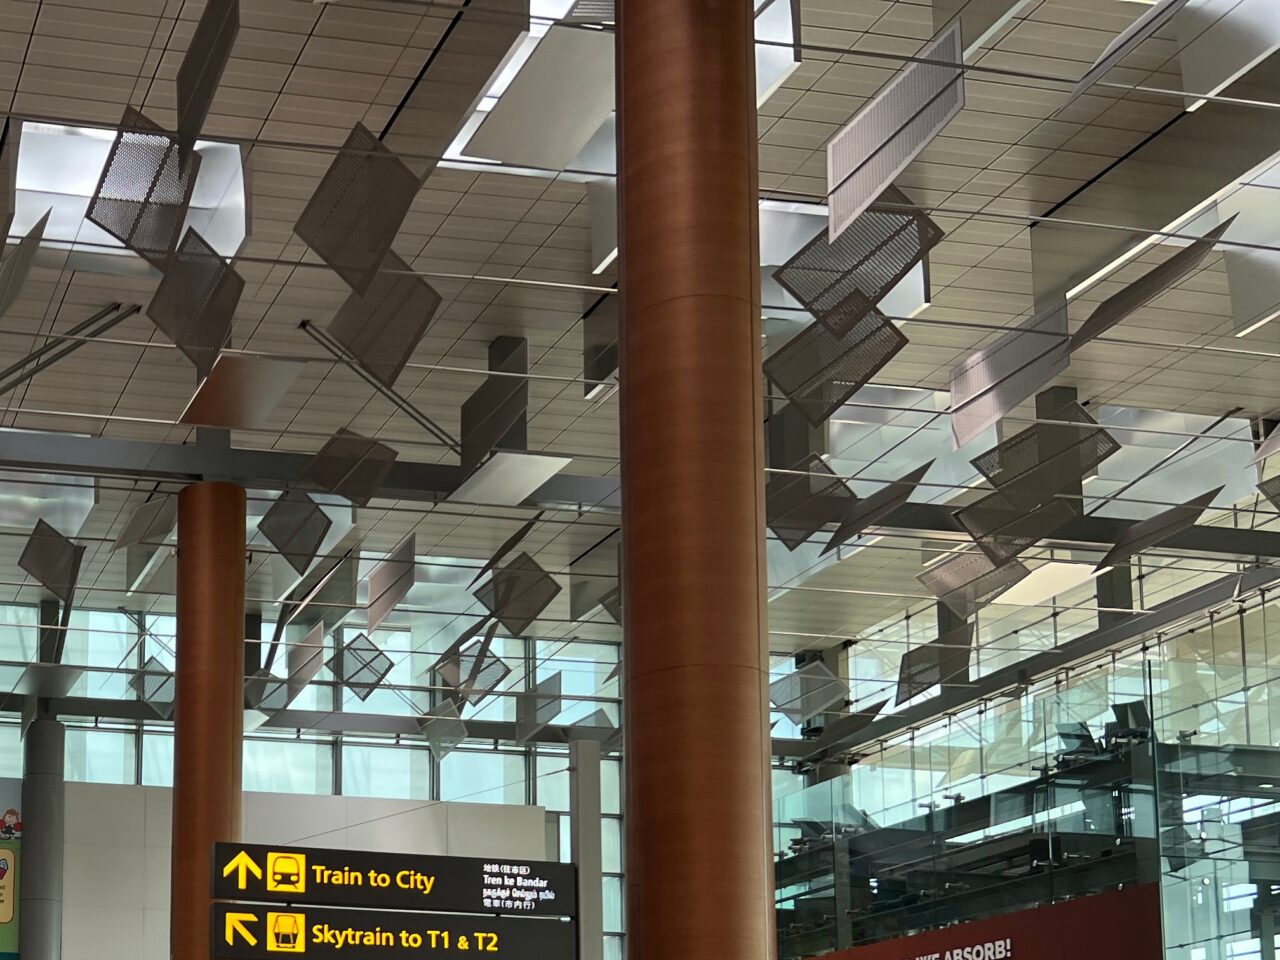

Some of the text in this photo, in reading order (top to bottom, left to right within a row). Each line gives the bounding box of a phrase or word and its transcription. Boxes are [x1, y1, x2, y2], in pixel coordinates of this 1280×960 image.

[312, 865, 435, 893] Train to City
[483, 874, 548, 887] Tren ke Bandar
[311, 924, 499, 952] Skytrain to T1 & T2
